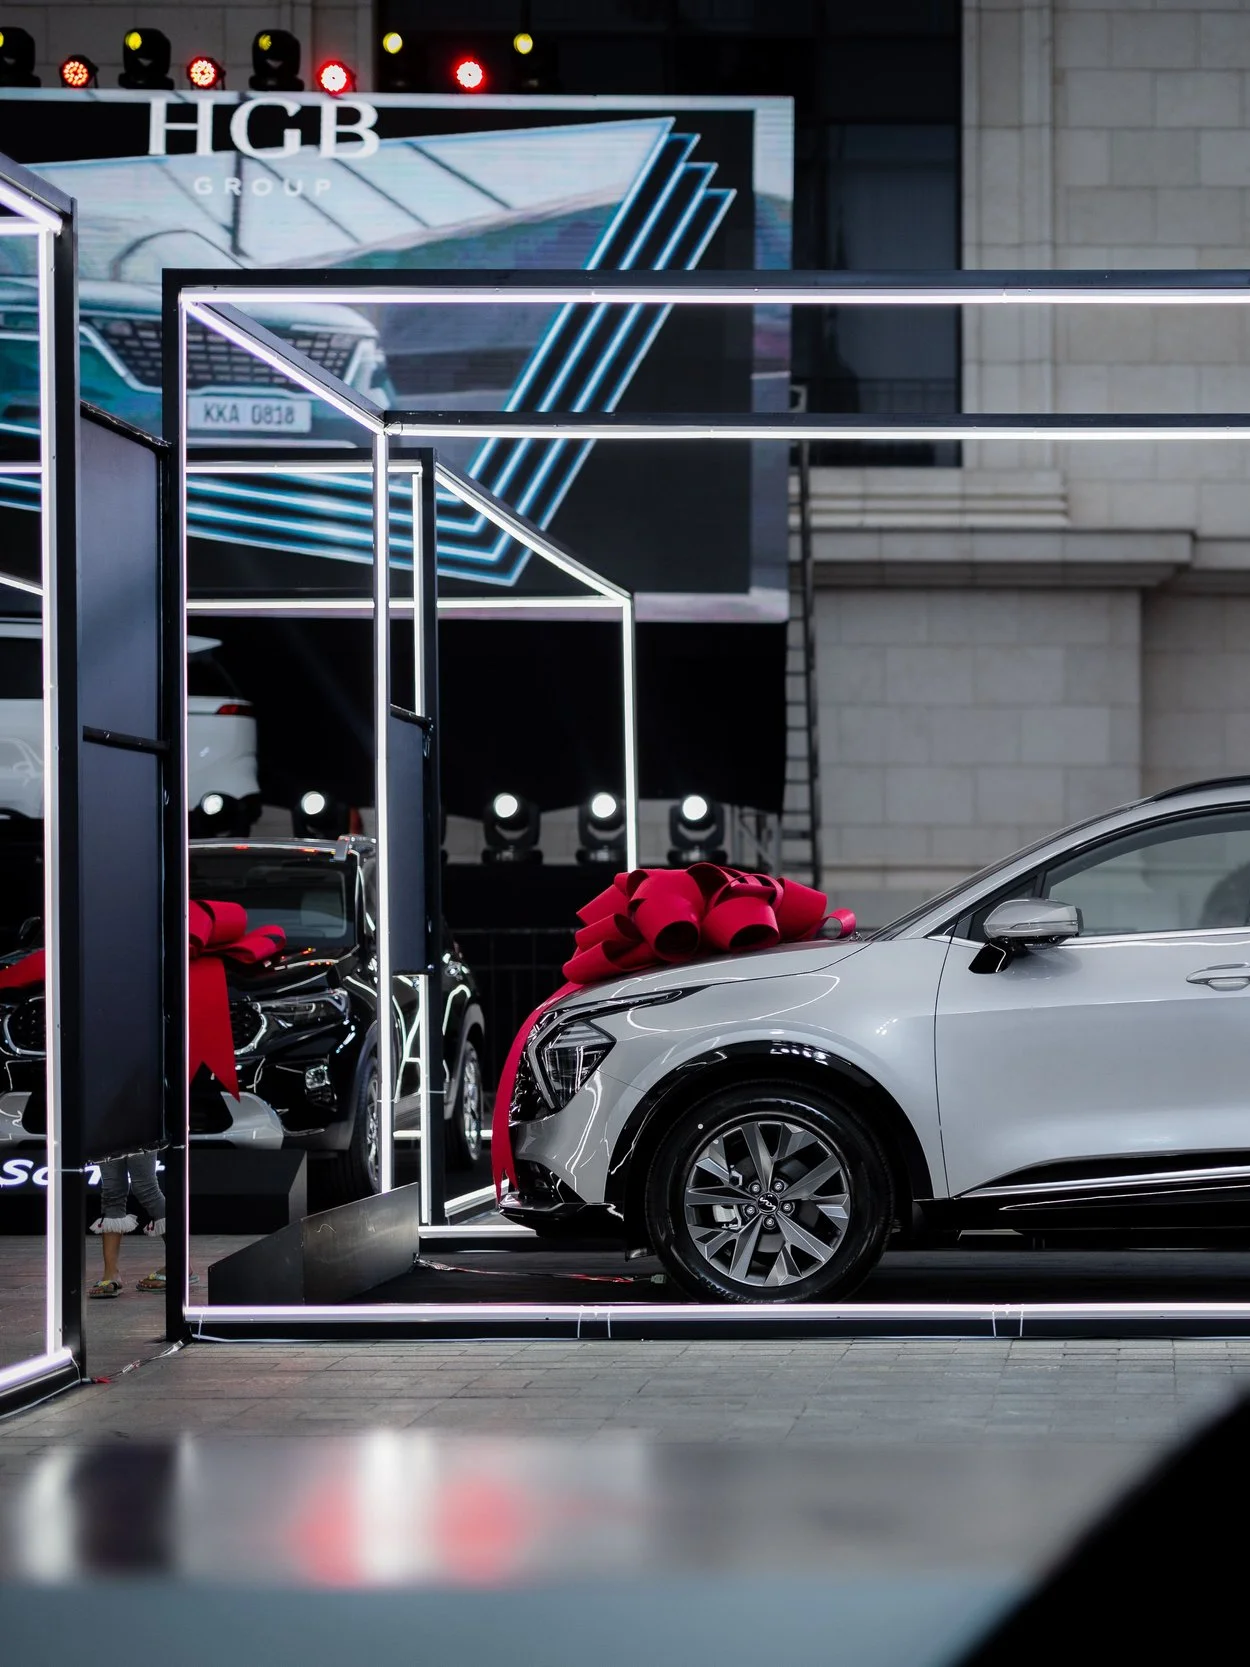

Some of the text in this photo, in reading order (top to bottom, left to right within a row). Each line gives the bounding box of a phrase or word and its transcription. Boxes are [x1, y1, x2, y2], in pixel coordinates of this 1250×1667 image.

[148, 97, 380, 159] HGB
[194, 176, 331, 197] GROUP
[203, 402, 240, 423] KKA
